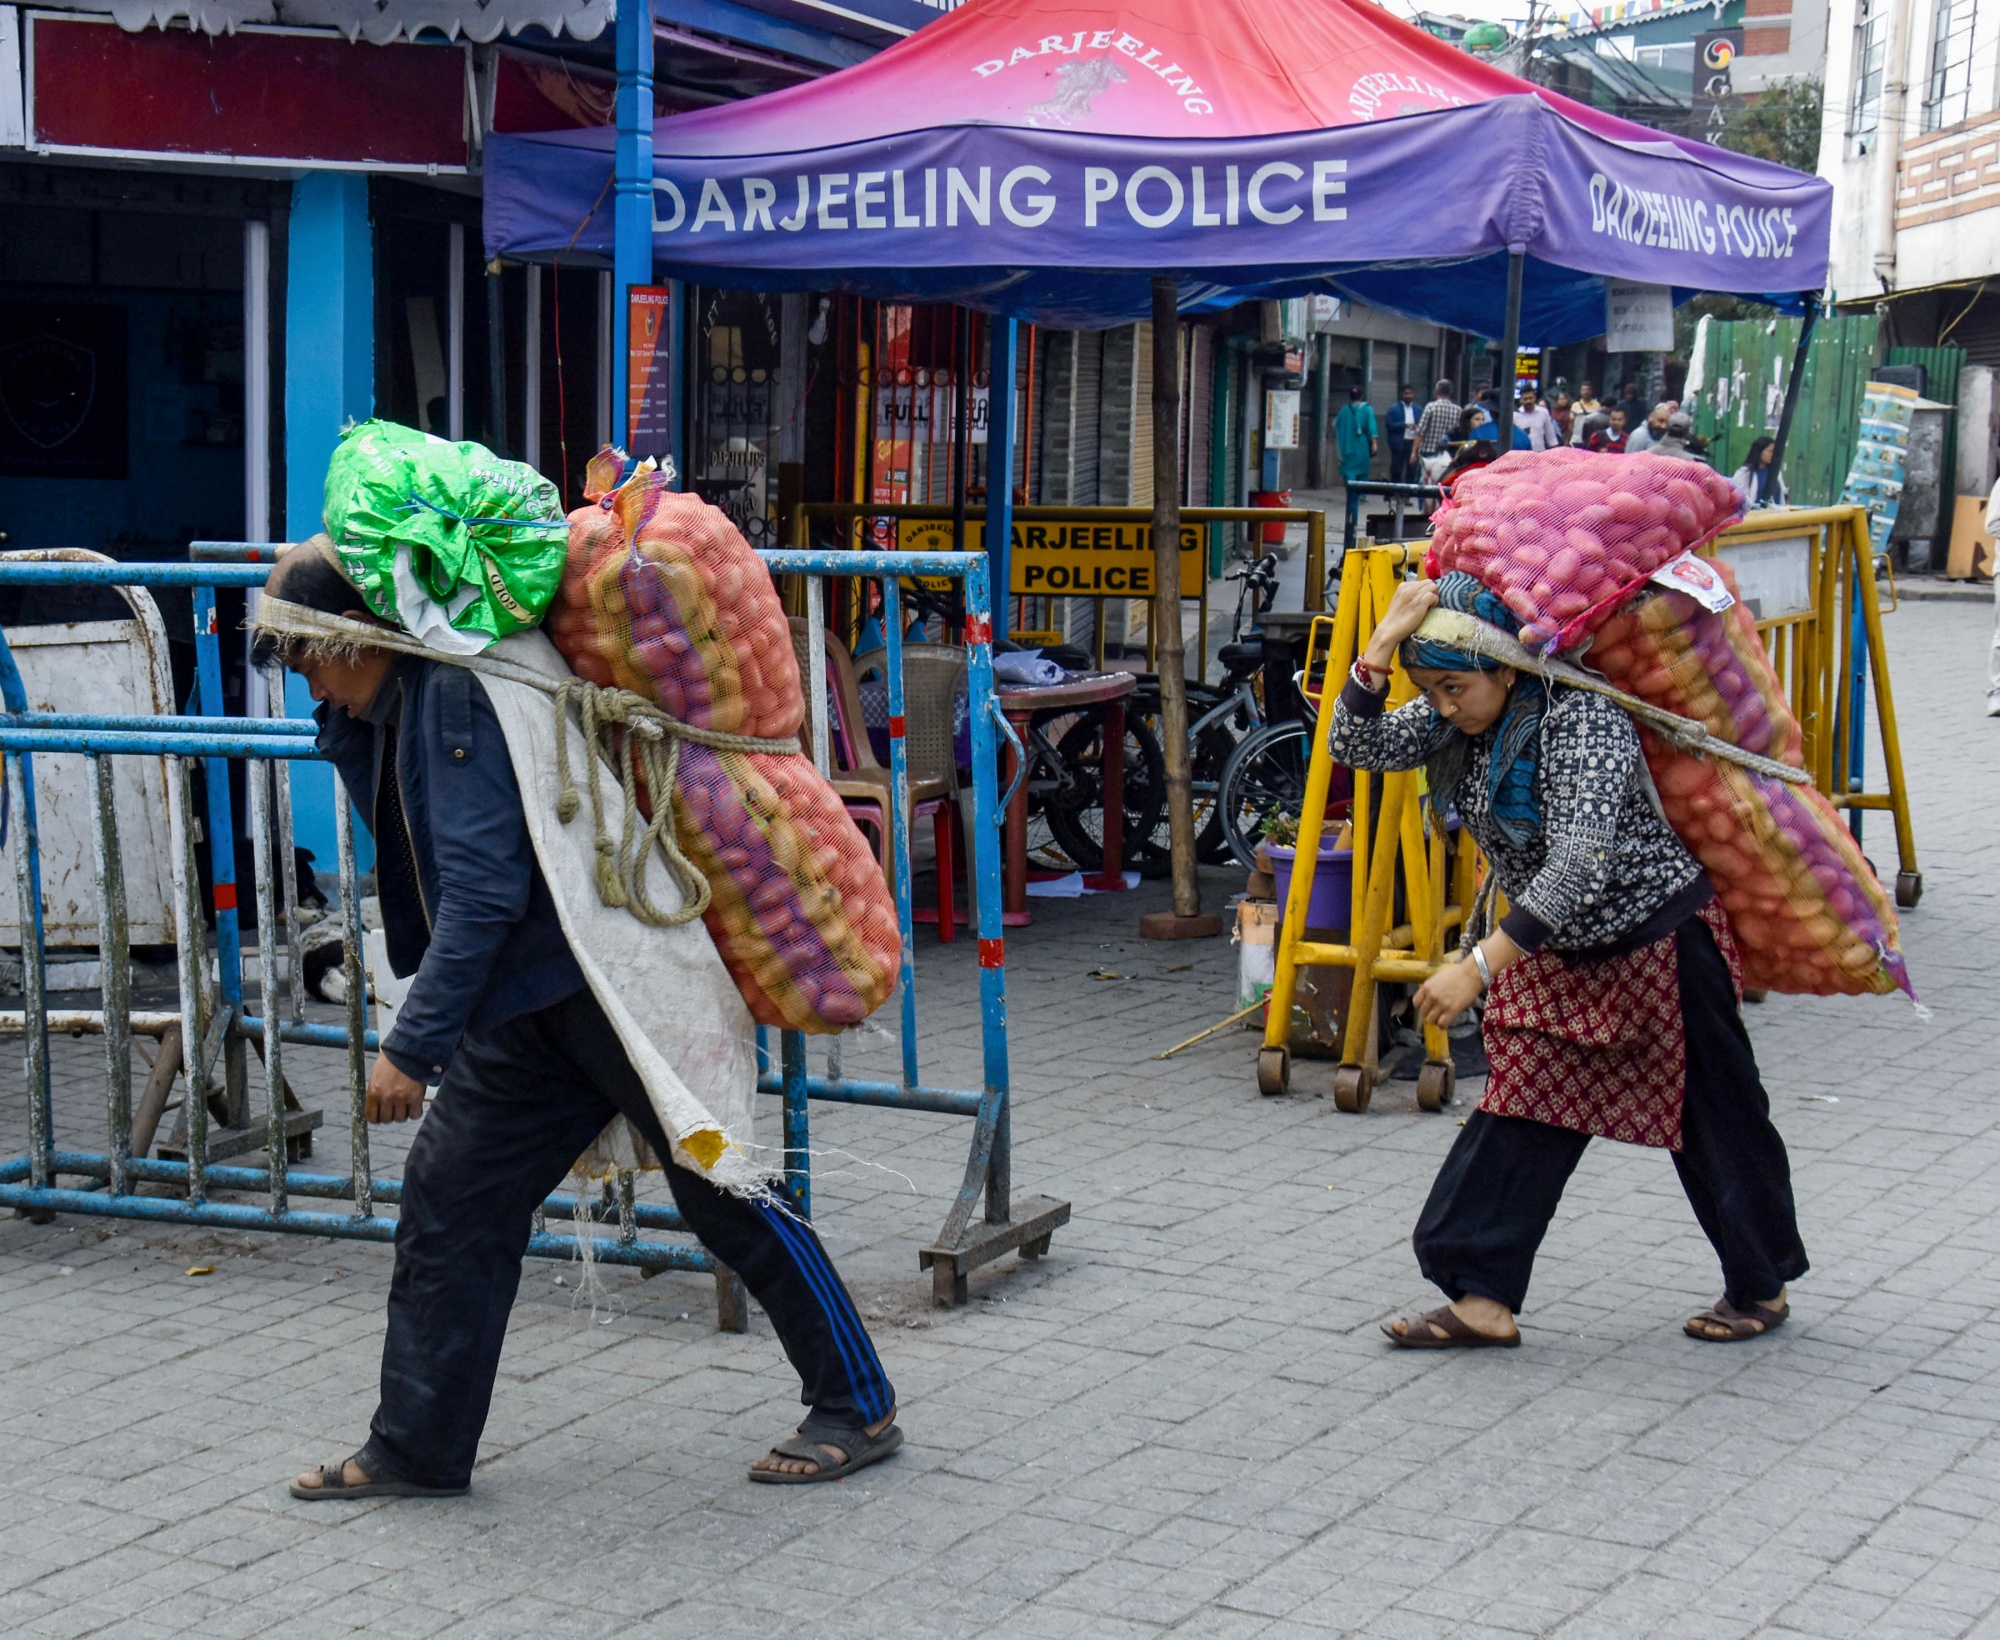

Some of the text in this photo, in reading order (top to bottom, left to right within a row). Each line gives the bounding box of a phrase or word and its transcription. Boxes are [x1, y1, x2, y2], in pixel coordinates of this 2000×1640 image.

[971, 29, 1214, 115] DARJEELING
[652, 160, 1348, 232] DARJEELING POLICE
[1589, 172, 1798, 259] DARJEELING POLICE
[885, 404, 929, 421] FULL
[981, 526, 1198, 552] ARJEELIG
[490, 573, 518, 611] GOLD
[1024, 565, 1149, 591] POLICE
